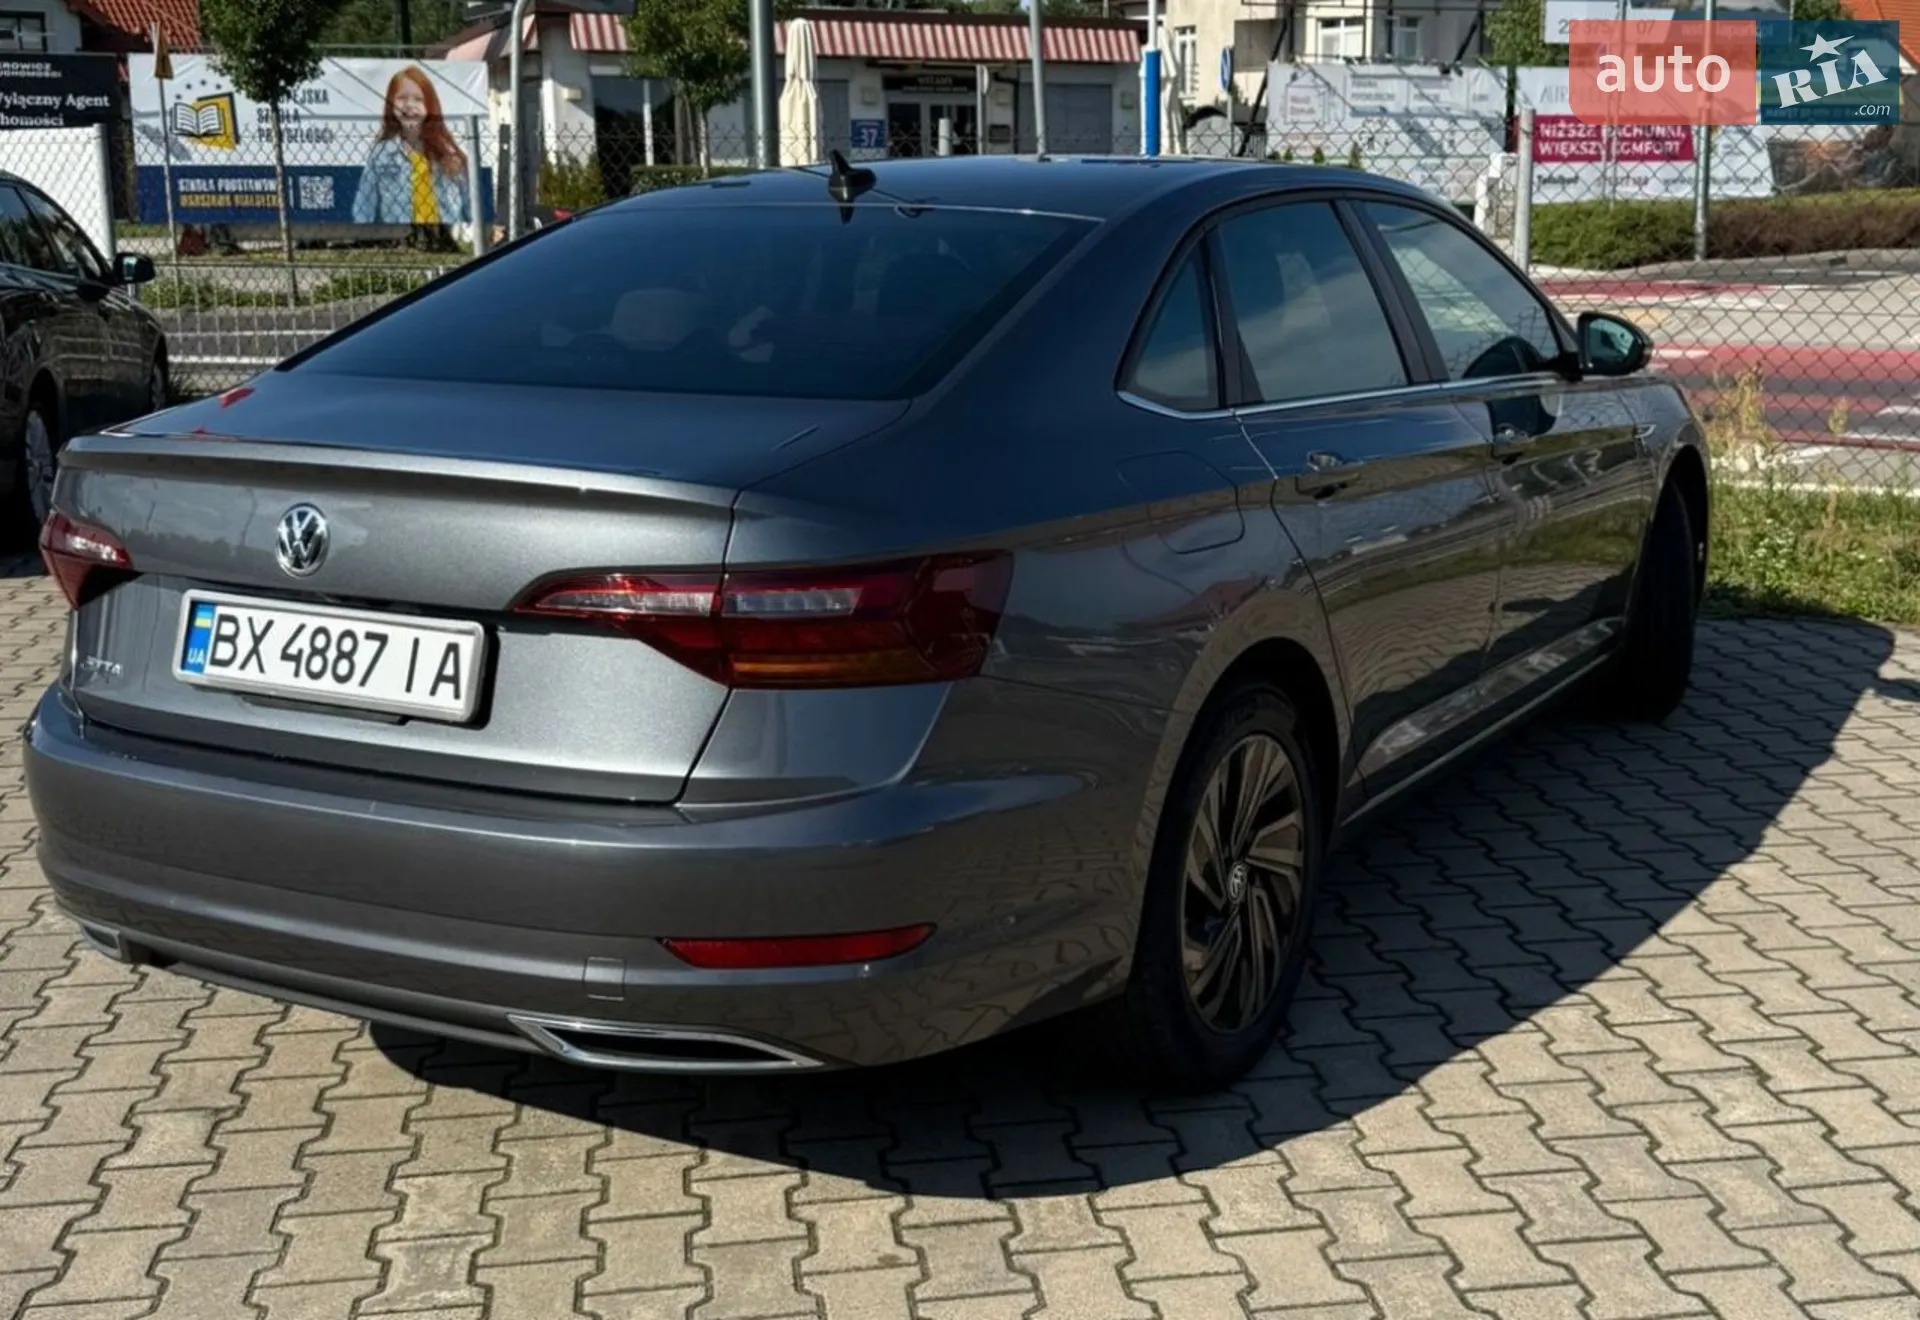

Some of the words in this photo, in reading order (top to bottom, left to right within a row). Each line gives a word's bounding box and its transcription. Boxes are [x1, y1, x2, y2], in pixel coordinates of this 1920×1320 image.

[65, 93, 110, 110] Agent
[860, 128, 878, 146] 37
[1540, 119, 1597, 138] NIŻSZE
[187, 651, 205, 664] UA
[210, 614, 274, 673] BX
[281, 622, 388, 687] 4887
